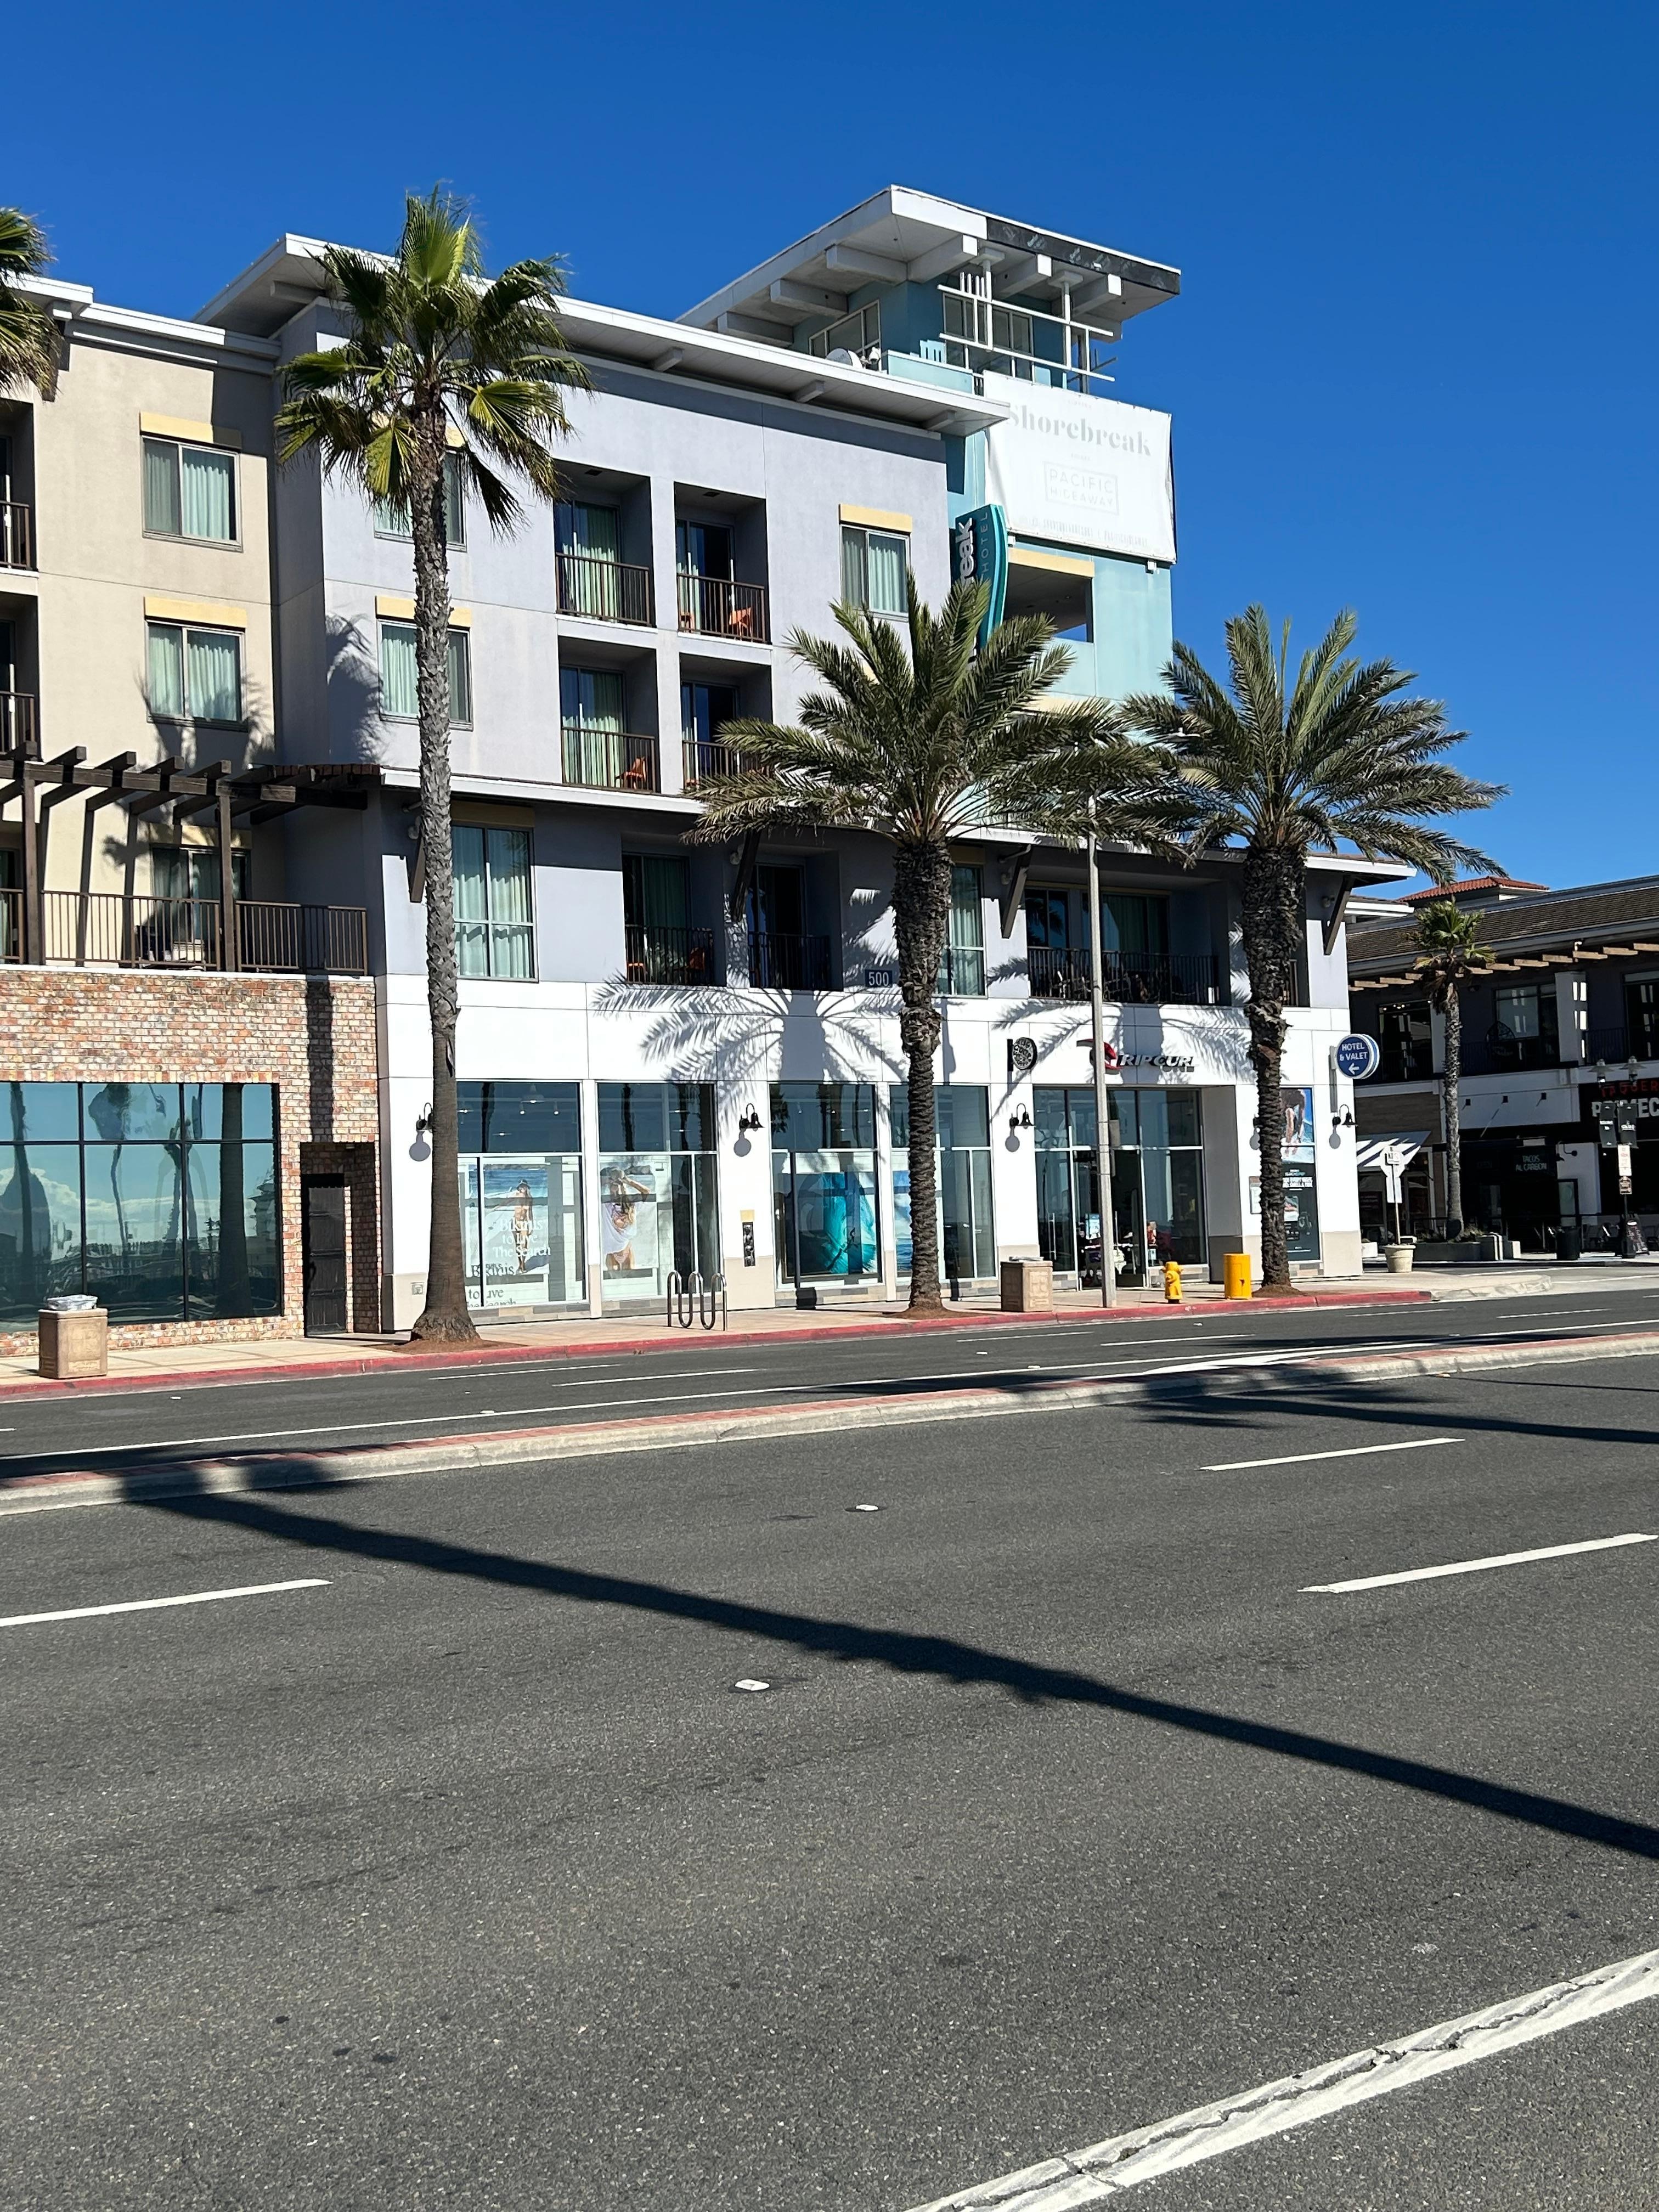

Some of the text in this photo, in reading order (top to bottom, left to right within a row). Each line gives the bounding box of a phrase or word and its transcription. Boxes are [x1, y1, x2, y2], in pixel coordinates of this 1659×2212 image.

[1049, 469, 1114, 493] PACIFIC
[1050, 486, 1113, 506] HIDEAWAY
[868, 971, 889, 986] 500
[1341, 1042, 1365, 1051] HOTEL
[1121, 1053, 1197, 1066] RIP CURL
[1345, 1052, 1368, 1060] VALET
[503, 1235, 514, 1244] to
[493, 1246, 514, 1257] The
